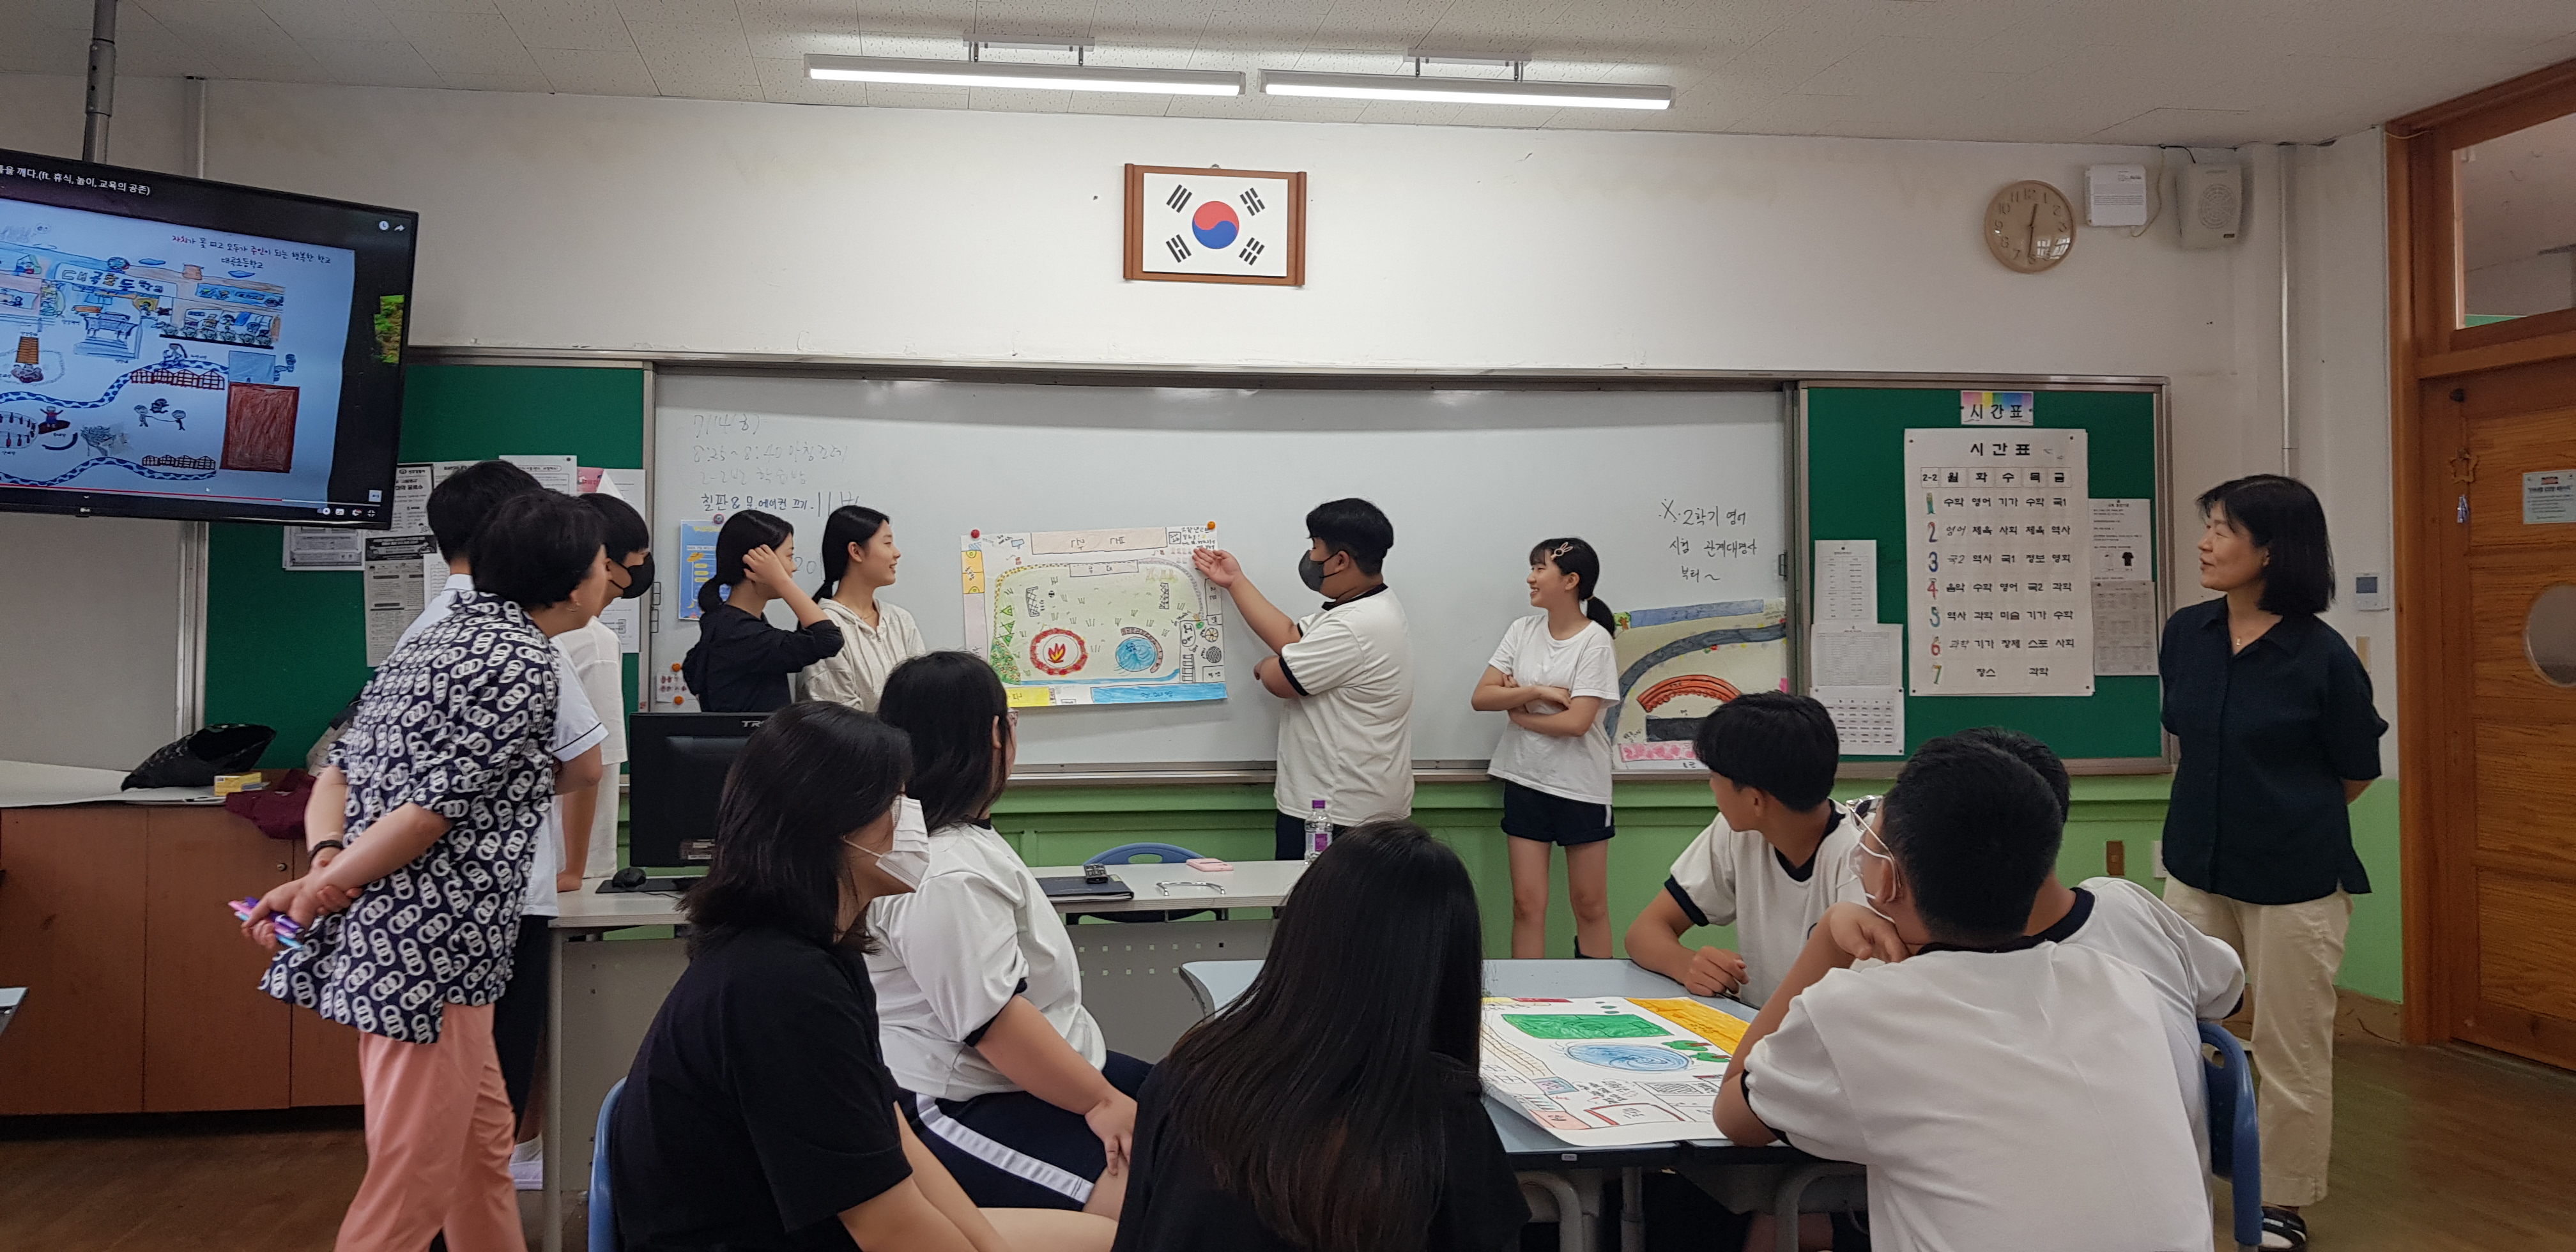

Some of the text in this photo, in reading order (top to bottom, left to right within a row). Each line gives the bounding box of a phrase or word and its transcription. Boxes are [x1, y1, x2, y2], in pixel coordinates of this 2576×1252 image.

[54, 173, 74, 185] 휴식,
[76, 176, 97, 188] 놀이,
[99, 179, 126, 192] 교육의
[129, 184, 150, 196] 공존)
[2044, 192, 2048, 204] 1
[227, 243, 247, 252] 모두가
[250, 246, 271, 256] 주인이
[274, 248, 288, 259] 되는
[1947, 472, 1959, 483] 월
[1975, 472, 1988, 483] 화
[2002, 472, 2014, 483] 수
[2030, 472, 2041, 483] 목
[2054, 472, 2065, 483] 금
[702, 492, 728, 511] 칠판
[1926, 492, 2067, 514] 1 수학 영어 기가 수학 국1
[1726, 508, 1746, 525] 영어
[1928, 521, 1938, 542] 2
[1946, 526, 1966, 536] 영어
[1999, 526, 2018, 535] 사회
[2051, 526, 2071, 535] 역사
[1669, 536, 1757, 558] 시험 관계대명사
[1928, 551, 1938, 572] 3
[1947, 554, 1965, 564] 국2
[1973, 554, 1992, 563] 역사
[2001, 554, 2015, 563] 국1
[2026, 554, 2045, 563] 정보
[1927, 577, 2072, 599] 4 음악 수학 영어 국2 과학
[1929, 606, 2073, 627] 5 역사 과학 미술 기가 수학
[1931, 636, 1941, 656] 6
[1949, 639, 1969, 650] 과학
[1974, 639, 1994, 649] 기가
[2028, 639, 2048, 648] 스포
[2055, 638, 2074, 648] 사회
[1932, 665, 1942, 685] 7
[2029, 667, 2049, 676] 과학
